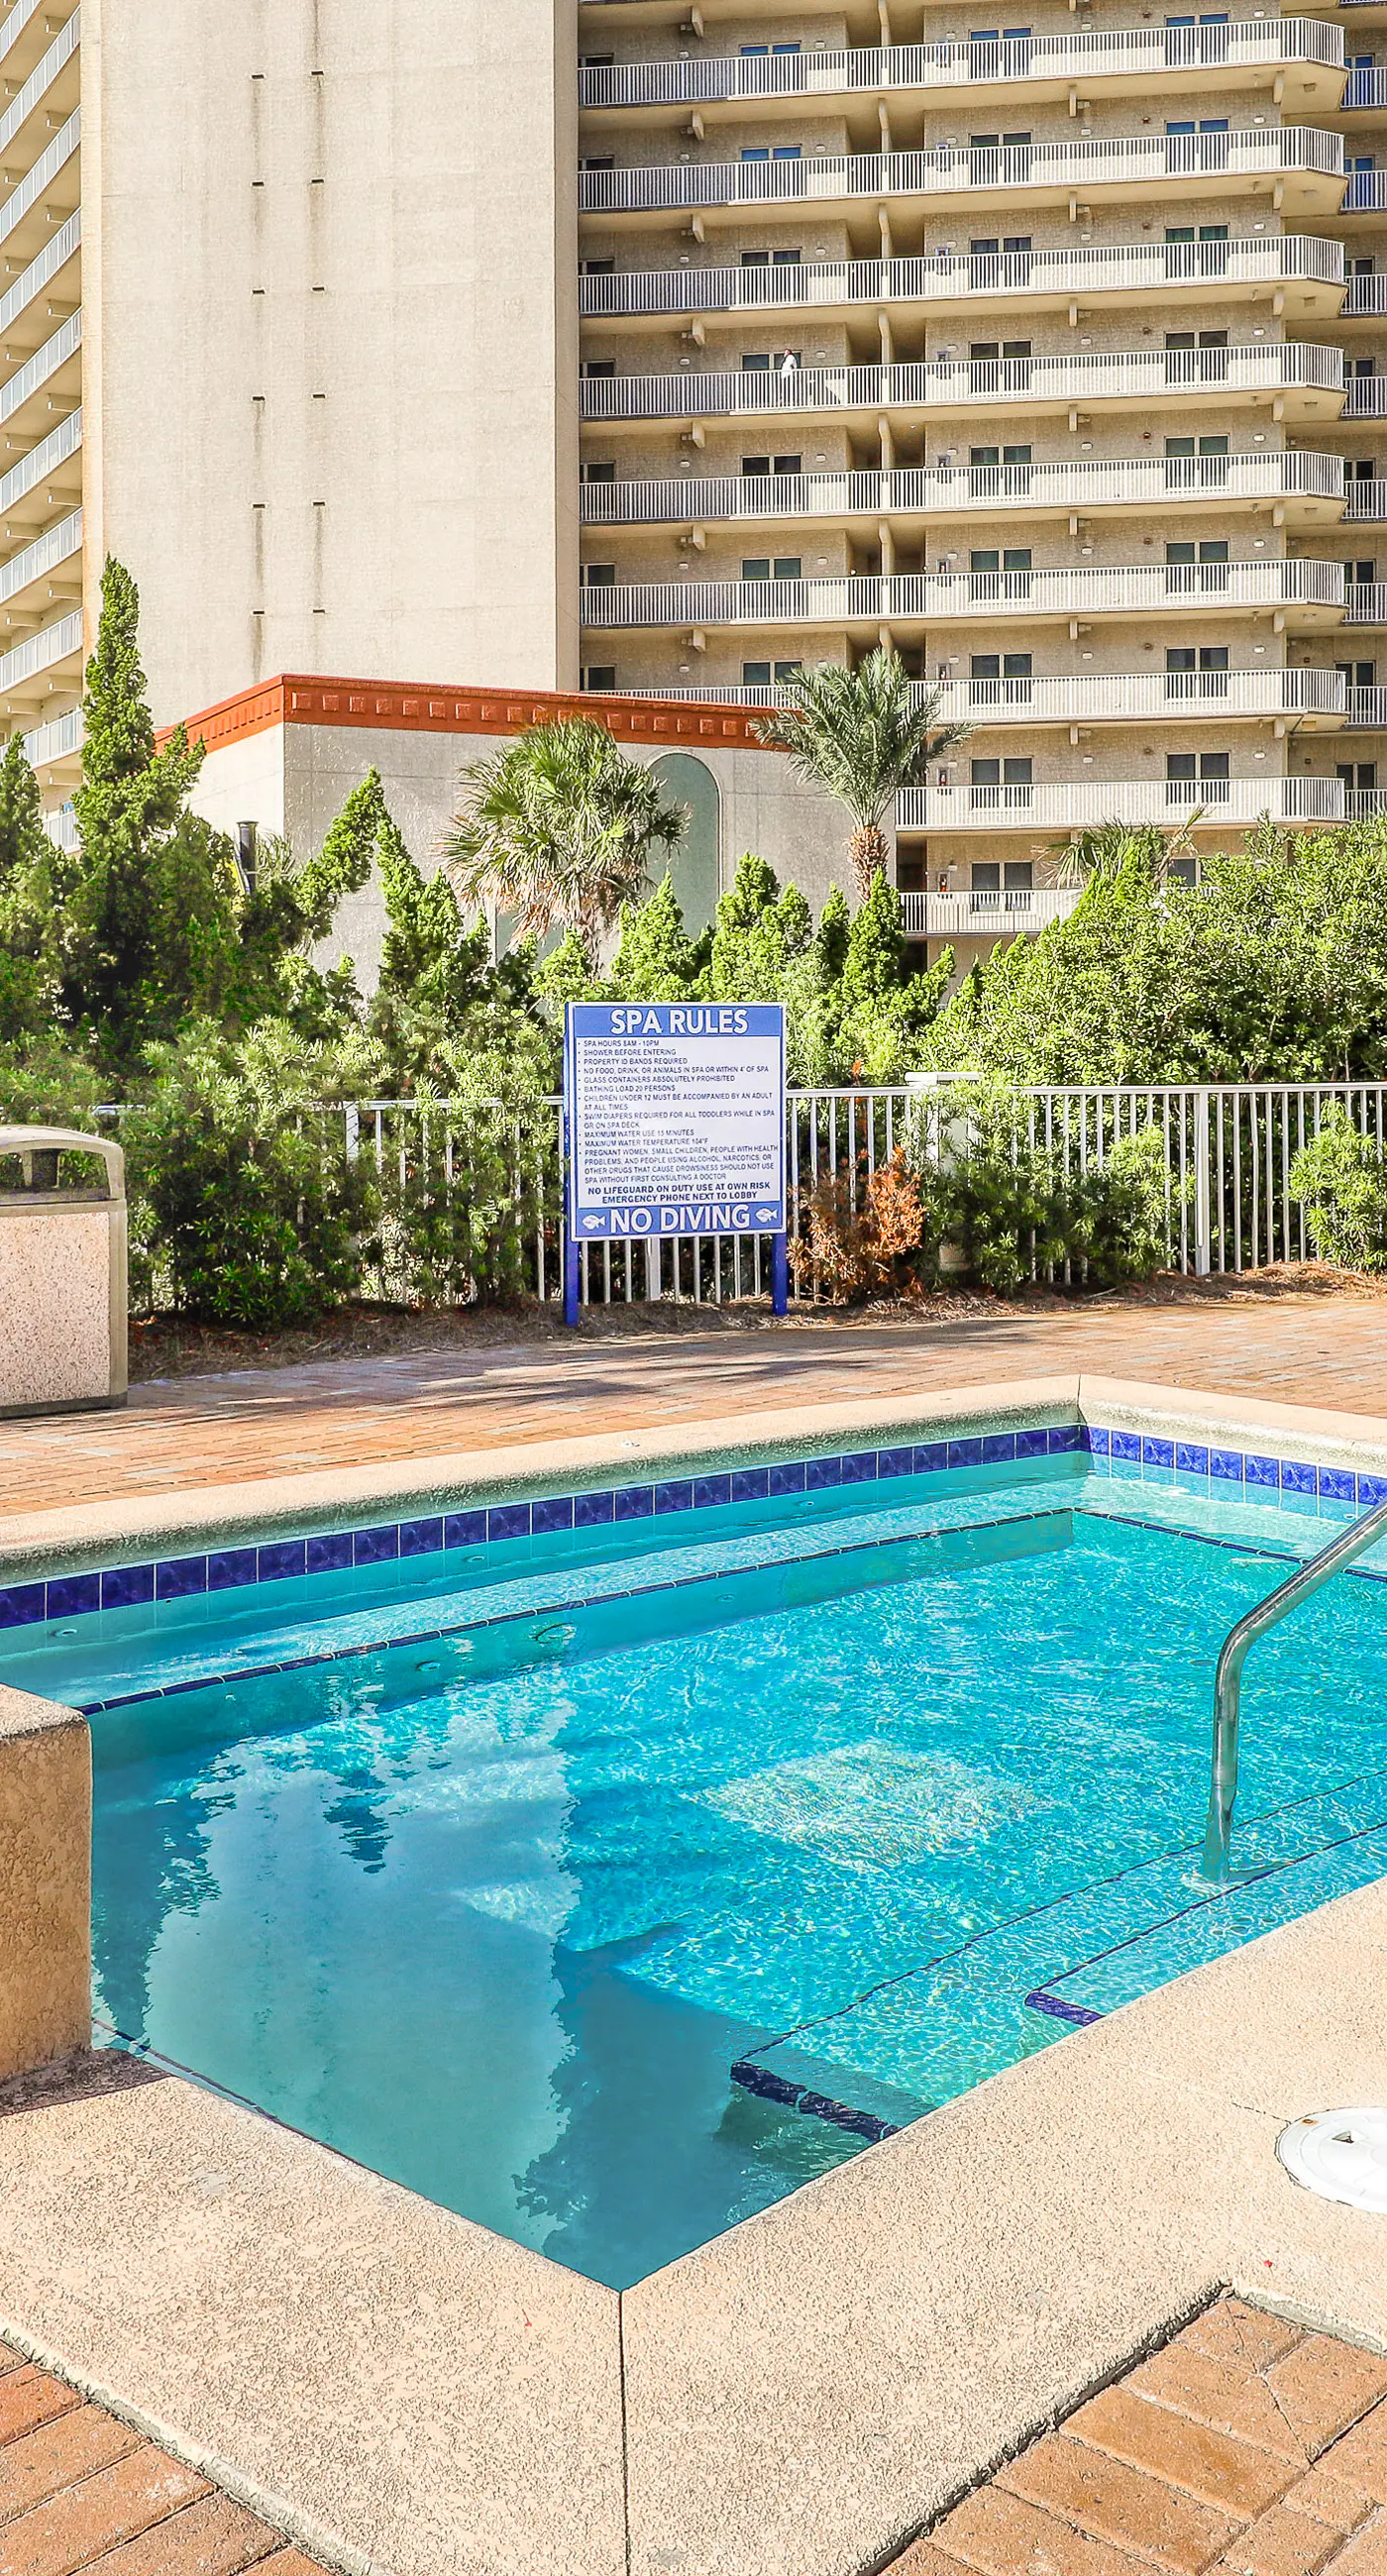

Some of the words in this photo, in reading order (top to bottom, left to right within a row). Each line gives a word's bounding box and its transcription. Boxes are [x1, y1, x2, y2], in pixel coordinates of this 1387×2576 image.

[610, 1009, 663, 1034] SPA
[669, 1009, 749, 1034] RULES
[603, 1186, 654, 1194] LIFEGUARD
[602, 1195, 658, 1204] EMERGENCY
[660, 1194, 691, 1202] PHONE
[610, 1207, 653, 1234] NO
[660, 1204, 750, 1232] DIVING
